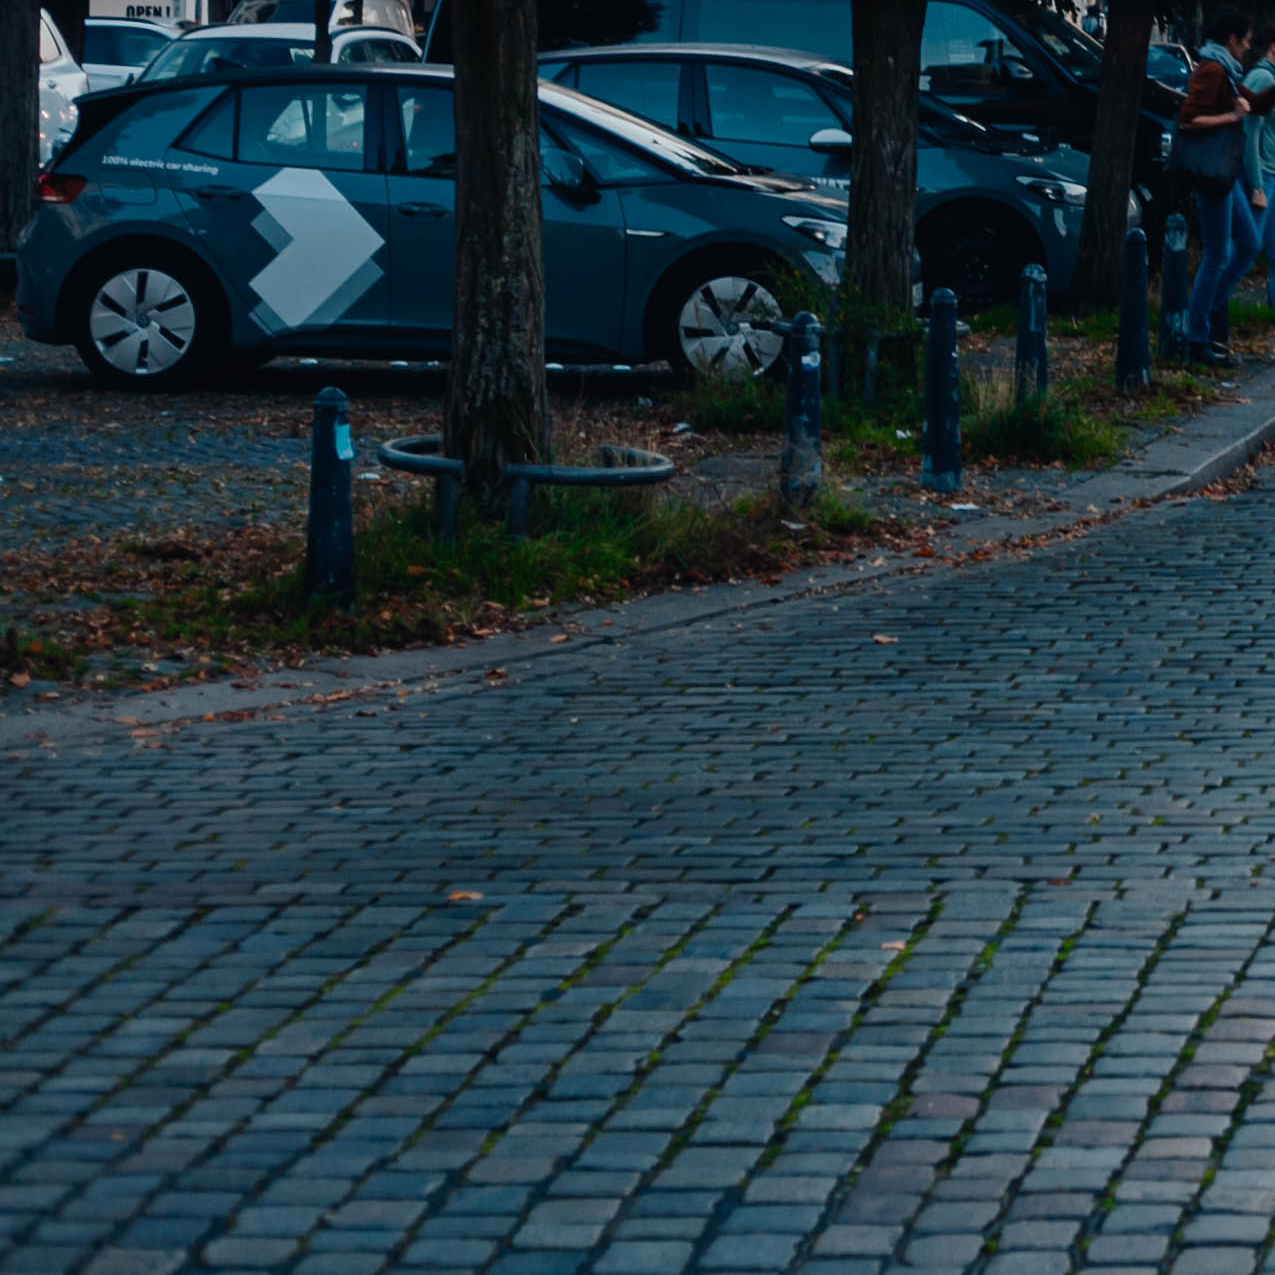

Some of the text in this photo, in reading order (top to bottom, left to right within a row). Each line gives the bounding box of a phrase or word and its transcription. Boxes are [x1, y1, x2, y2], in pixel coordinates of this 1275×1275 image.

[126, 5, 162, 18] OPEN
[101, 155, 219, 176] 100% electric car sharing
